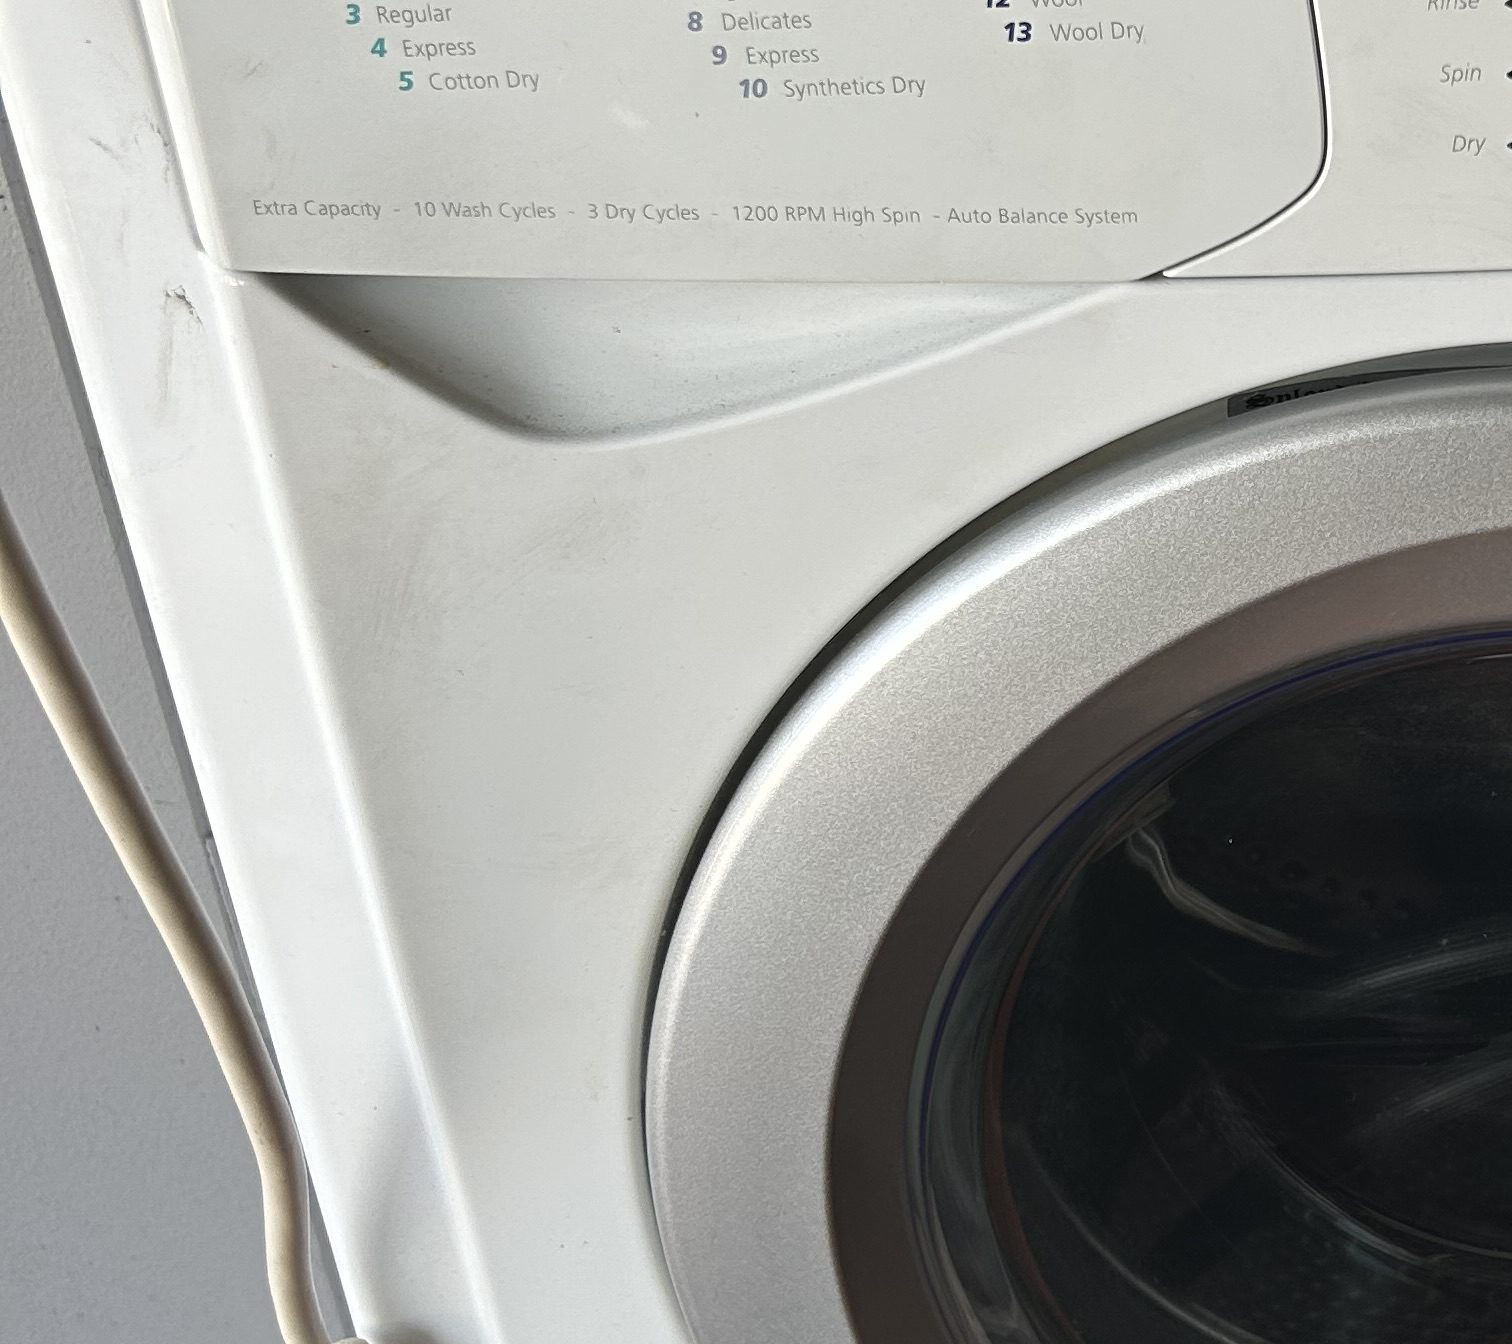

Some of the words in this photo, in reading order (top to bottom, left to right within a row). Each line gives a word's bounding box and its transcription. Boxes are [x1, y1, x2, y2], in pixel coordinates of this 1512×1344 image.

[345, 3, 361, 25] 3
[375, 3, 452, 29] Regular
[687, 10, 704, 32] 8
[720, 11, 813, 32] Delicates
[1004, 21, 1032, 43] 13
[1049, 21, 1103, 42] Wool
[1110, 21, 1144, 44] Dry
[370, 37, 388, 58] 4
[401, 39, 477, 62] Express
[711, 45, 728, 66] 9
[745, 46, 820, 69] Express
[398, 70, 414, 92] 5
[428, 72, 500, 91] Cotton
[505, 69, 539, 93] Dry
[1439, 64, 1482, 87] Spin
[738, 78, 768, 99] 10
[783, 77, 886, 102] Synthetics
[891, 75, 926, 98] Dry
[1452, 135, 1487, 157] Dry
[252, 199, 298, 216] Extra
[303, 199, 382, 221] Capacity
[414, 201, 437, 218] 10
[440, 201, 493, 218] Wash
[498, 201, 557, 223] Cycles
[588, 203, 599, 220] 3
[604, 203, 636, 224] Dry
[642, 203, 700, 225] Cycles
[732, 205, 779, 222] 1200
[784, 205, 826, 222] RPM
[832, 206, 875, 227] High
[881, 206, 921, 227] Spin
[947, 207, 992, 224] Auto
[998, 207, 1069, 224] Balance
[1074, 207, 1138, 228] System
